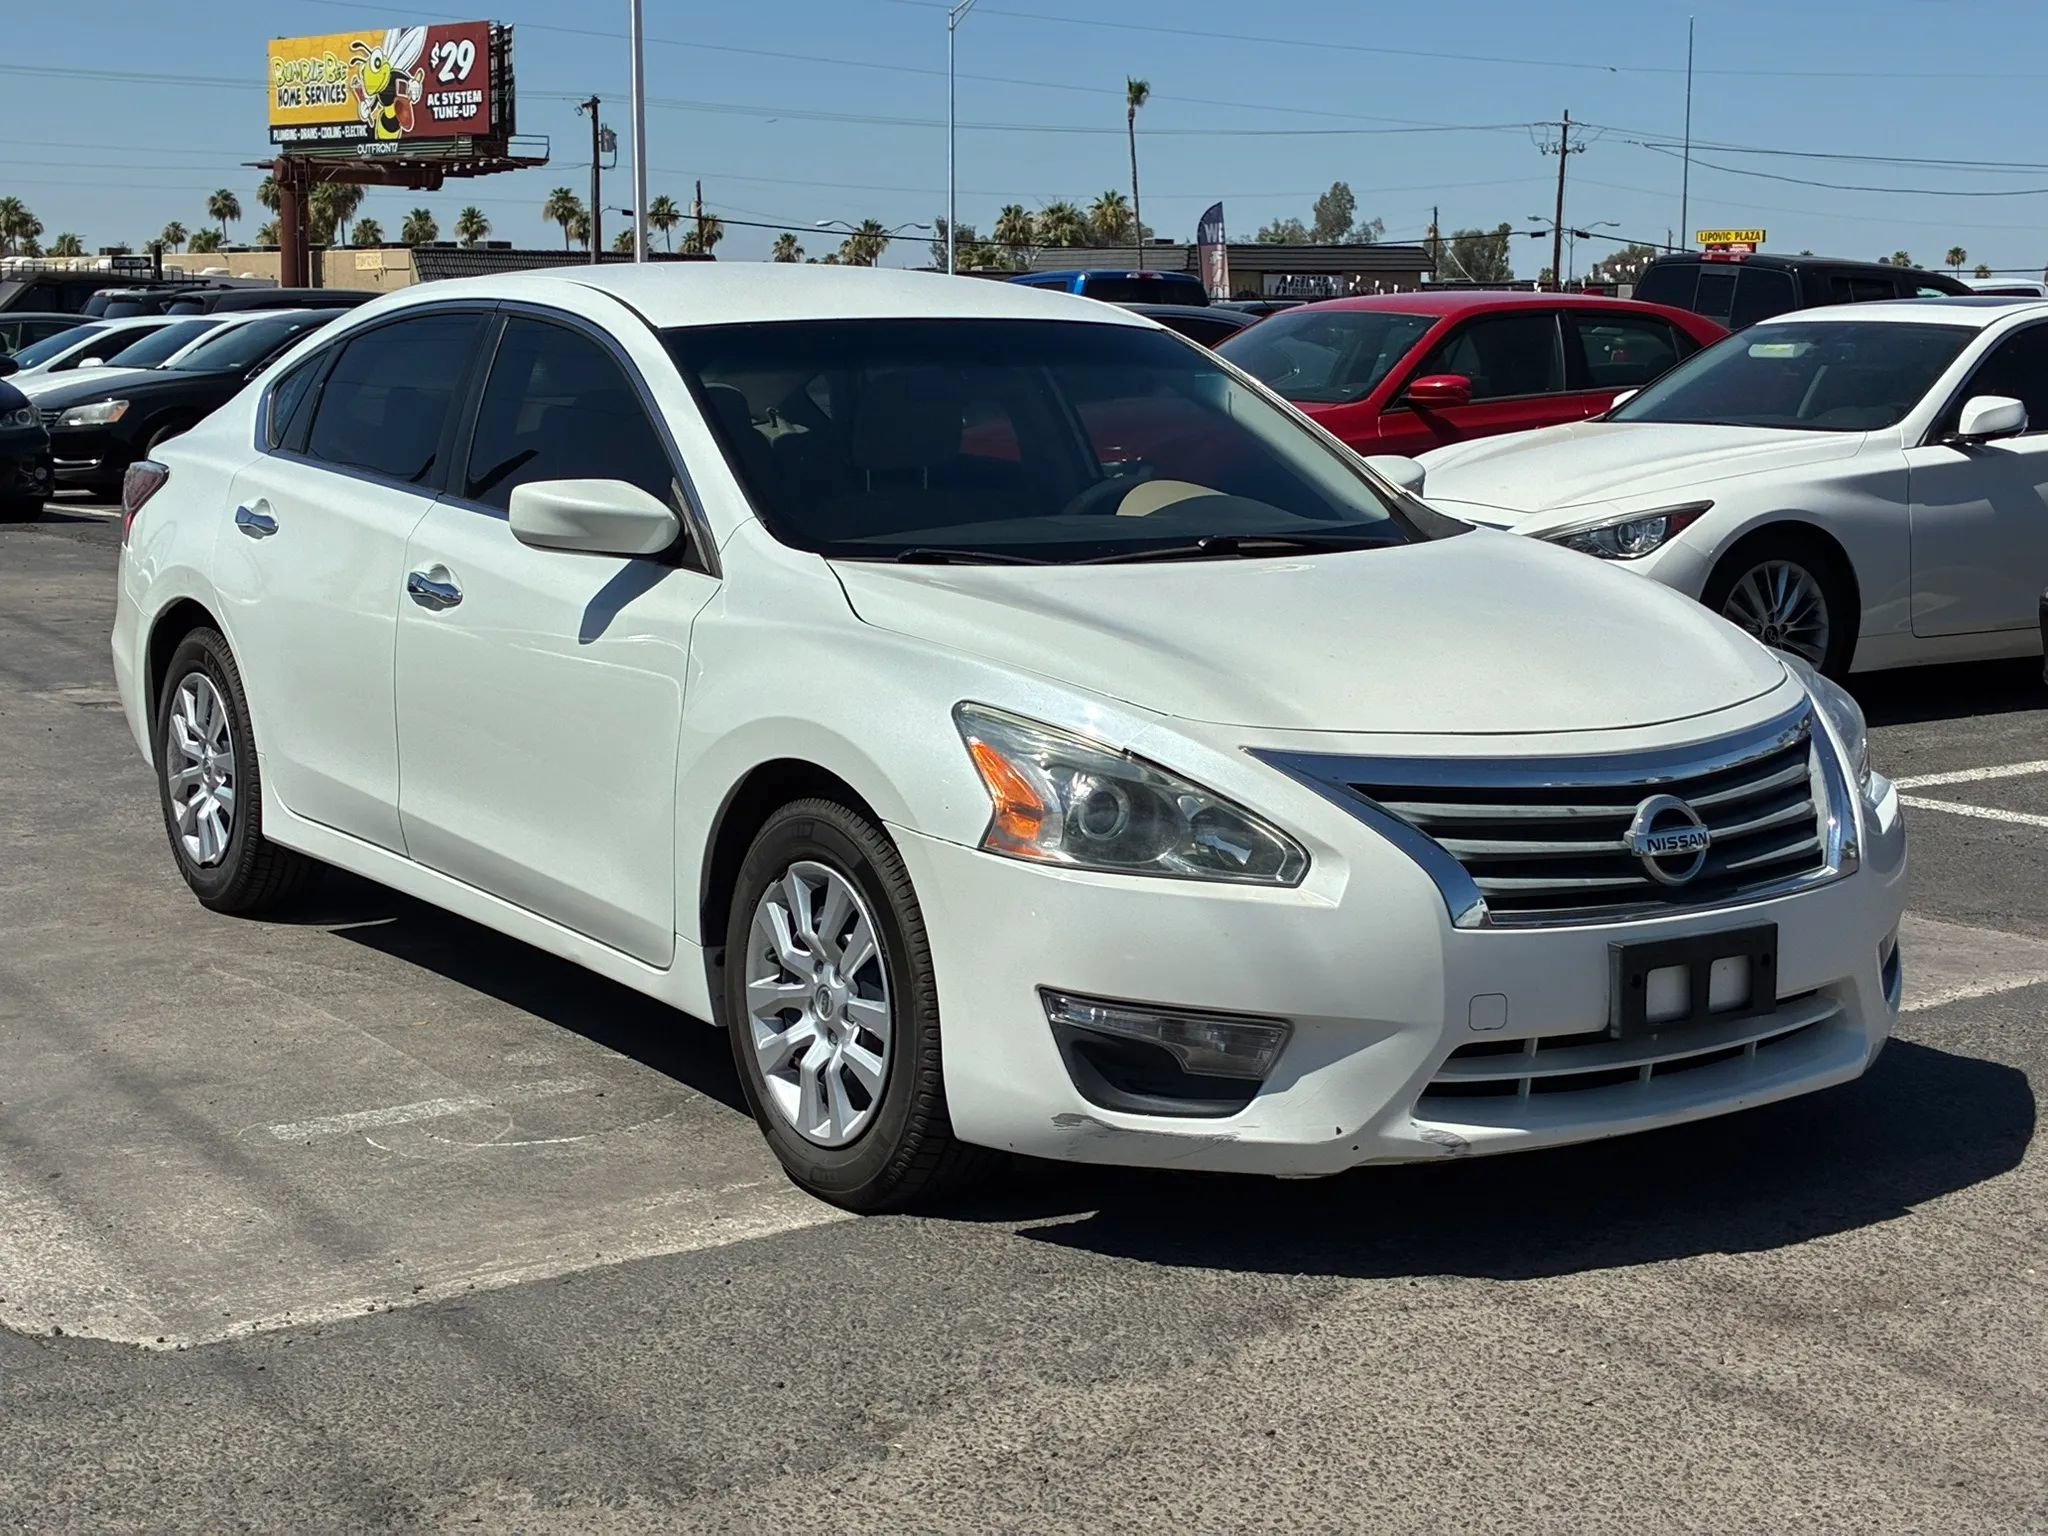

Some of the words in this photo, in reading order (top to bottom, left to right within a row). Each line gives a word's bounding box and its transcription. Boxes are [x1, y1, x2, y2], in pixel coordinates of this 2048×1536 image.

[323, 52, 347, 83] BEE
[430, 39, 476, 82] $29
[277, 86, 301, 107] HOME
[304, 83, 347, 105] SERVICES
[427, 93, 440, 106] AC
[441, 90, 482, 104] SYSTEM
[432, 104, 477, 119] TUNE-UP
[1700, 231, 1731, 241] LIPOVIC
[1734, 231, 1760, 240] PLAZA
[1646, 832, 1707, 851] NISSAN
